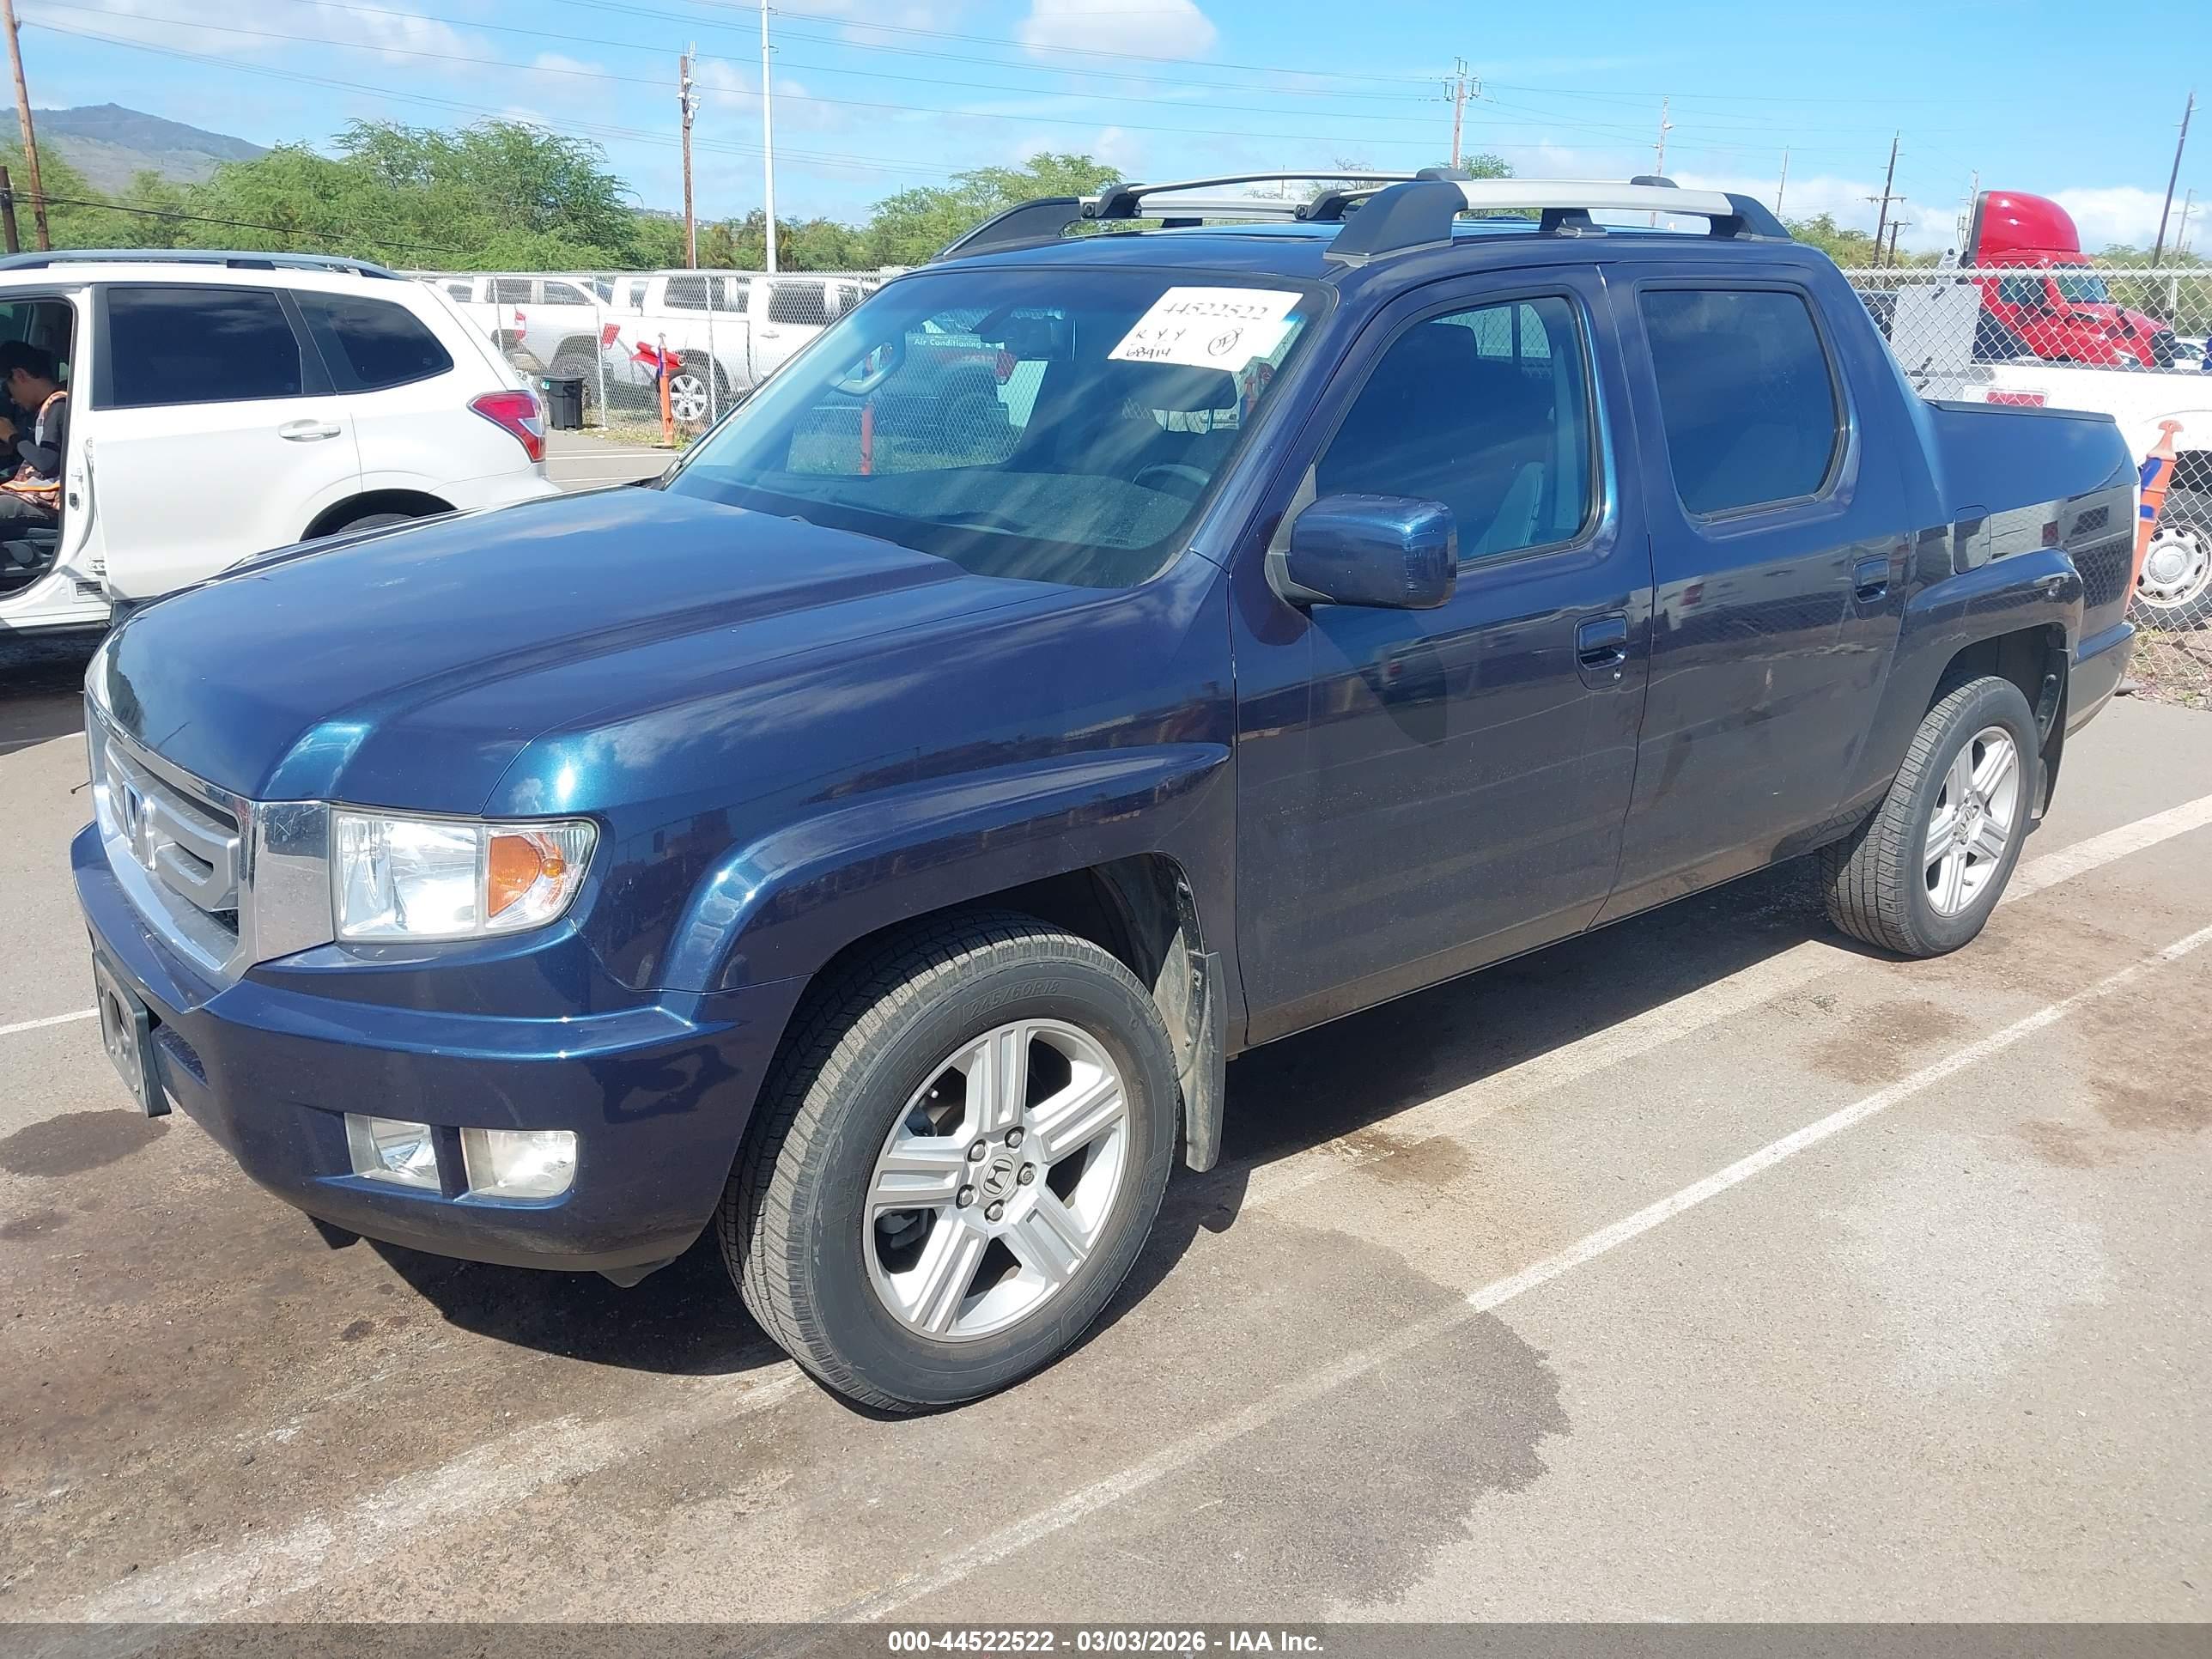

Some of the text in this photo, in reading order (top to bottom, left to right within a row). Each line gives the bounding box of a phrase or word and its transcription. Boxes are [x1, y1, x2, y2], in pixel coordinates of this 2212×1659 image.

[1163, 302, 1268, 320] 44522522
[929, 338, 981, 349] Conditioning
[1126, 346, 1171, 359] 68914
[970, 981, 1060, 1018] 245/60R18
